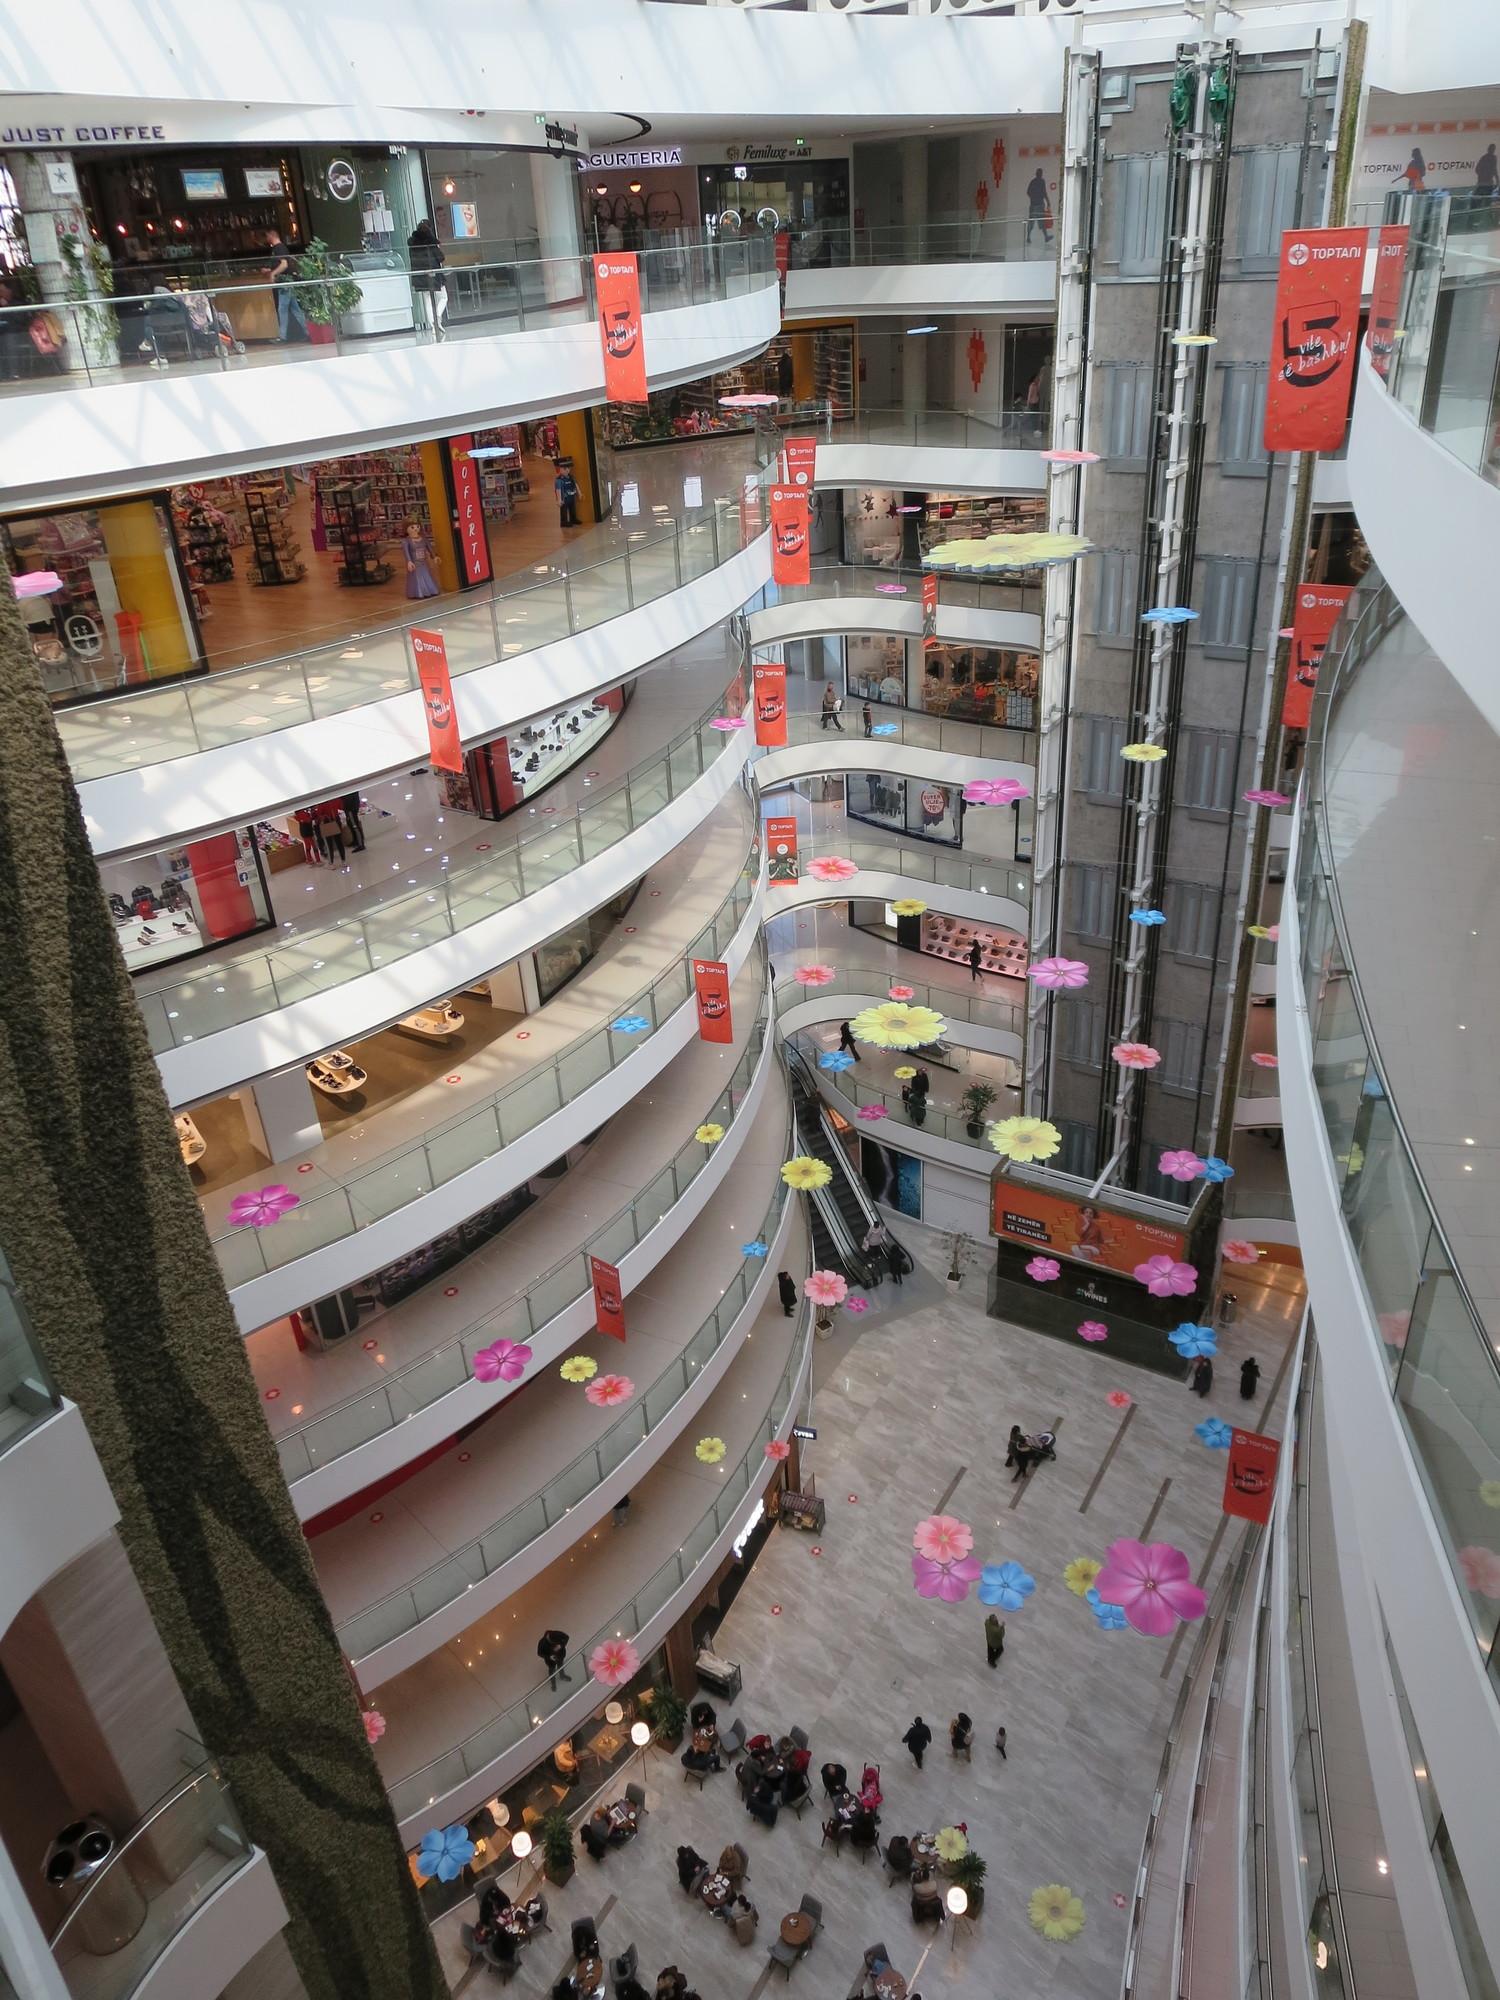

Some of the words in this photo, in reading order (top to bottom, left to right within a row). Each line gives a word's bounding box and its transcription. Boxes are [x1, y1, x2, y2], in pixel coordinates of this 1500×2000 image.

[2, 128, 65, 142] JUST
[76, 126, 165, 141] COFFEE
[587, 150, 681, 168] GURTERIA
[743, 145, 788, 159] Femiluxe
[1364, 164, 1402, 173] TOPTANI
[1437, 161, 1475, 170] TOPTANI
[1311, 247, 1361, 259] TOPTANI
[1300, 334, 1322, 354] vite
[1143, 1225, 1177, 1241] TOPTANI
